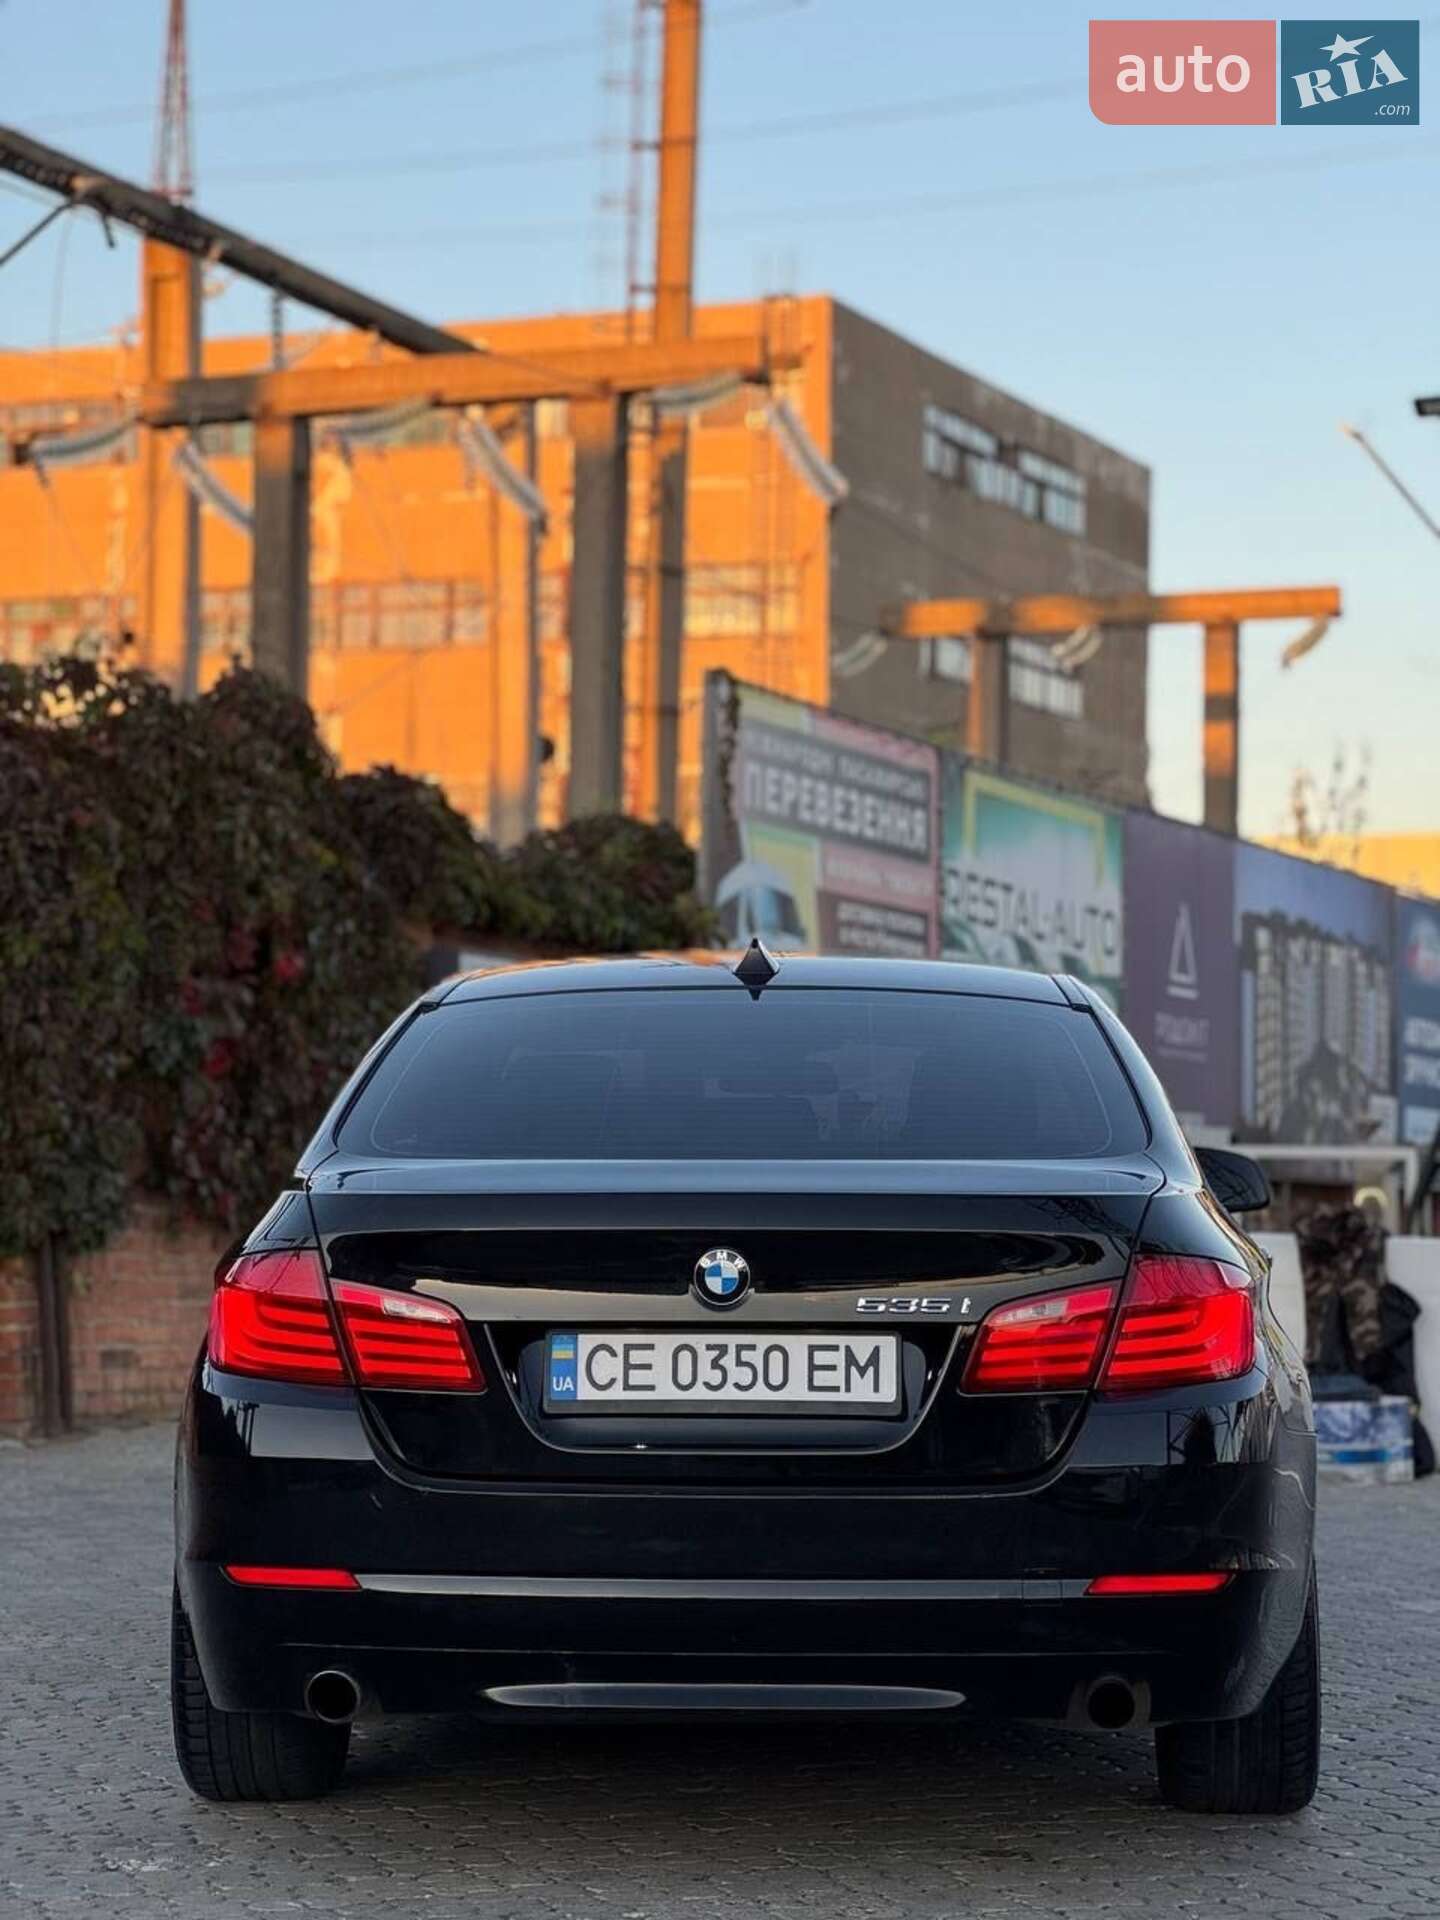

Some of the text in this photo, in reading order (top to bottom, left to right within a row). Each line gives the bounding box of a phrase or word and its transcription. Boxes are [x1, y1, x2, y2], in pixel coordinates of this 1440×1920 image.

[585, 1343, 880, 1393] CE 0350 EM
[553, 1377, 575, 1392] UA
